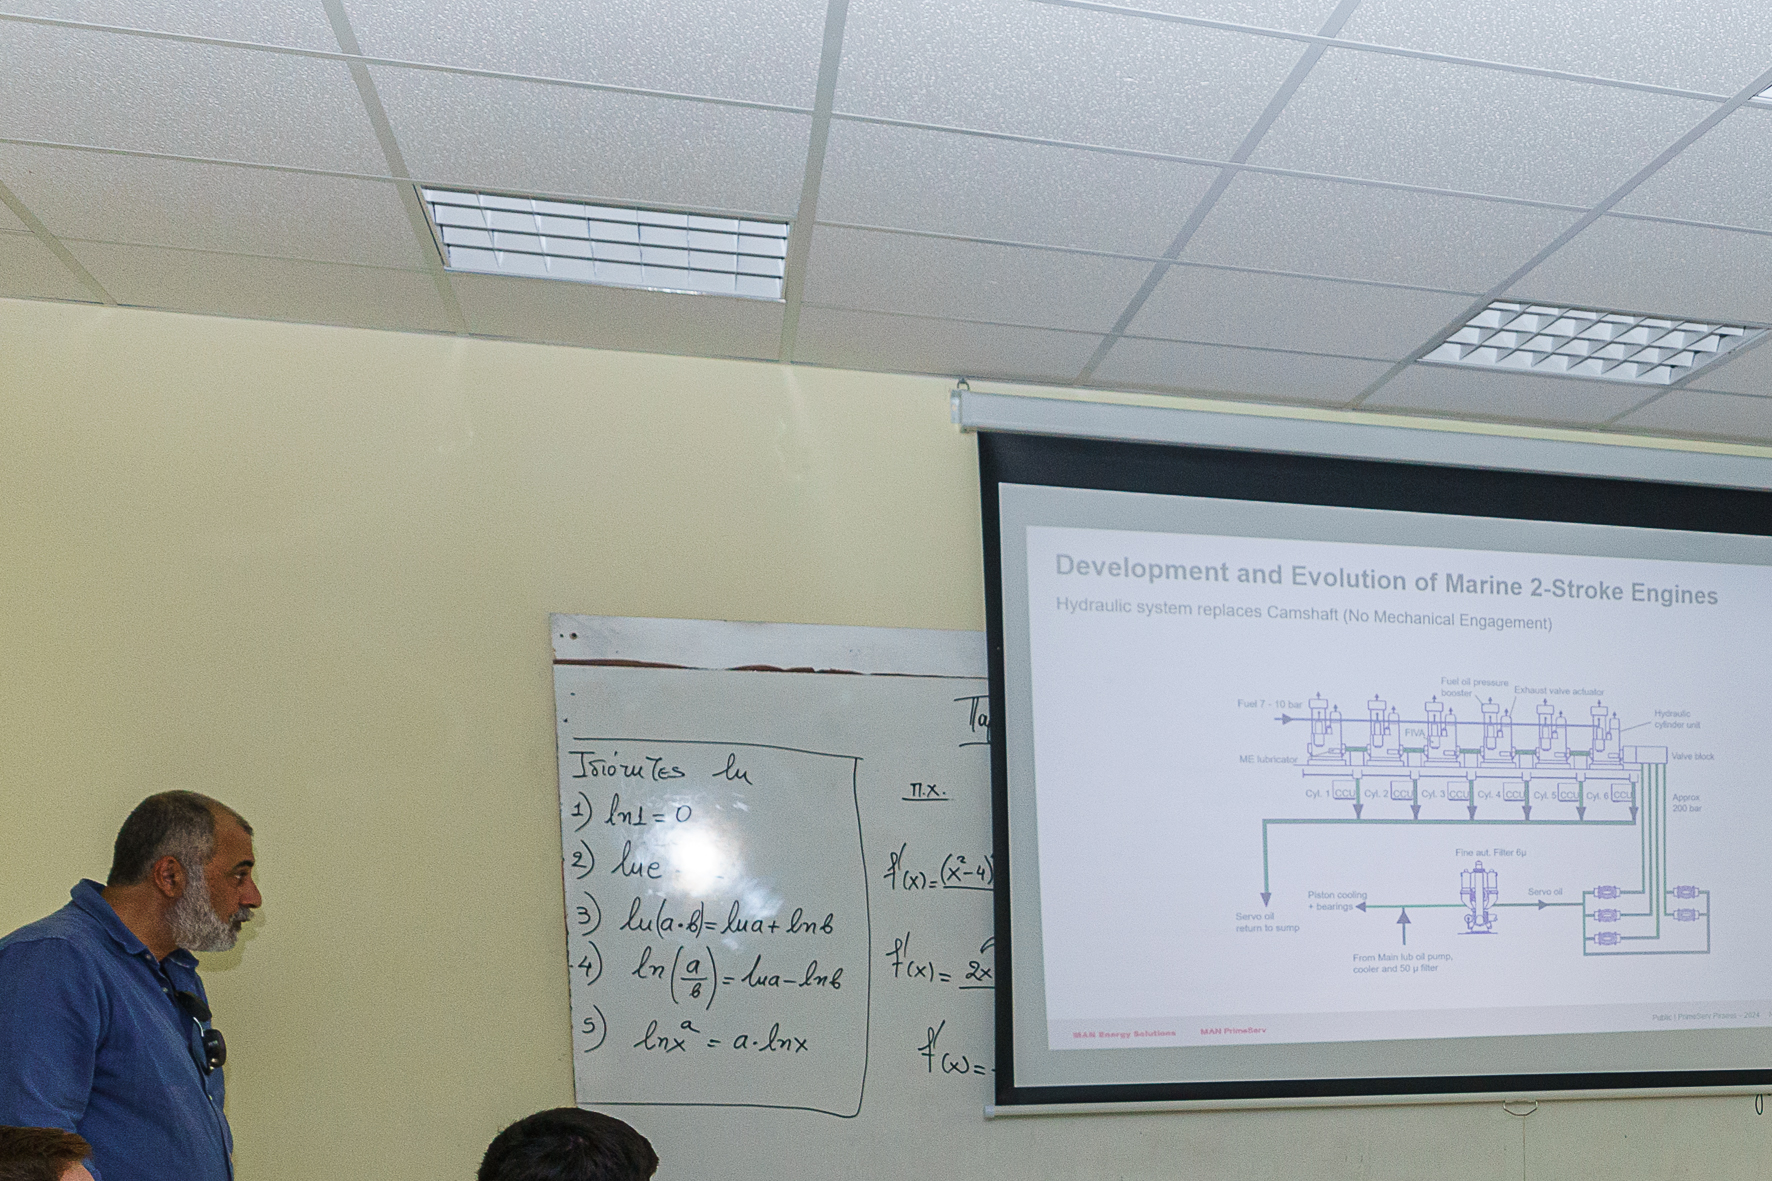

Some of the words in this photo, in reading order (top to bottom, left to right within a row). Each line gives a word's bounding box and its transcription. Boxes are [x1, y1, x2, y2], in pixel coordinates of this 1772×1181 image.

[1056, 554, 1229, 584] Development
[1237, 565, 1282, 585] and
[1291, 565, 1407, 591] Evolution
[1415, 573, 1438, 592] of
[1446, 573, 1523, 596] Marine
[1530, 578, 1624, 600] 2-Stroke
[1631, 582, 1719, 608] Engines
[1056, 597, 1132, 614] Hydraulic
[1137, 602, 1193, 617] system
[1197, 604, 1262, 620] replaces
[1267, 605, 1339, 622] Camshaft
[1343, 608, 1369, 625] (No
[1374, 610, 1455, 627] Mechanical
[1460, 613, 1553, 632] Engagement)
[1441, 677, 1462, 687] Fuel
[1473, 679, 1509, 689] pressure
[1441, 688, 1472, 697] booster
[1514, 685, 1547, 696] Exhaust
[1549, 687, 1570, 696] valve
[1572, 688, 1604, 697] actuator
[1237, 699, 1258, 708] Fuel
[1260, 700, 1266, 709] 7
[1274, 700, 1286, 709] 10
[1287, 700, 1302, 709] bar
[1654, 709, 1691, 719] Hydraulic
[1654, 720, 1684, 730] cylinder
[1686, 720, 1700, 729] unit
[1404, 728, 1426, 737] FIVA
[1239, 755, 1255, 764] ME
[1257, 755, 1298, 764] lubricator
[1671, 752, 1693, 761] Valve
[1694, 752, 1715, 761] block
[1305, 789, 1322, 799] Cyl.
[1325, 789, 1330, 798] 1
[1364, 789, 1381, 799] Cyl.
[1382, 789, 1389, 798] 2
[1421, 790, 1438, 800] Cyl.
[1440, 790, 1446, 799] 3
[1477, 790, 1495, 800] Cyl.
[1495, 790, 1501, 799] 4
[1533, 791, 1550, 801] Cyl.
[1551, 791, 1557, 800] 5
[1586, 791, 1602, 801] Cyl.
[1603, 791, 1609, 800] 6
[570, 791, 593, 833] 1)
[1672, 804, 1687, 813] 200
[1689, 804, 1702, 813] bar
[1455, 849, 1475, 857] Fine
[1493, 848, 1514, 857] Filter
[570, 839, 595, 880] 2)
[1308, 890, 1335, 899] Piston
[1337, 890, 1368, 901] cooling
[1528, 887, 1551, 896] Servo
[1554, 887, 1563, 896] oil
[1316, 902, 1354, 912] bearings
[577, 891, 602, 936] 3)
[1235, 912, 1262, 921] Servo
[1264, 912, 1275, 921] oil
[1236, 924, 1262, 933] return
[1264, 924, 1273, 932] to
[1276, 925, 1300, 935] sump
[1353, 953, 1375, 962] From
[1378, 953, 1398, 962] Main
[1400, 953, 1414, 962] lub
[1416, 953, 1425, 961] oil
[1427, 953, 1453, 963] pump,
[1353, 965, 1379, 974] cooler
[1382, 964, 1398, 973] and
[1400, 964, 1411, 973] 50
[1420, 963, 1438, 972] filter
[1099, 1031, 1131, 1040] Energy
[1133, 1029, 1176, 1038] Solutions
[1224, 1027, 1266, 1035] PrimeServ
